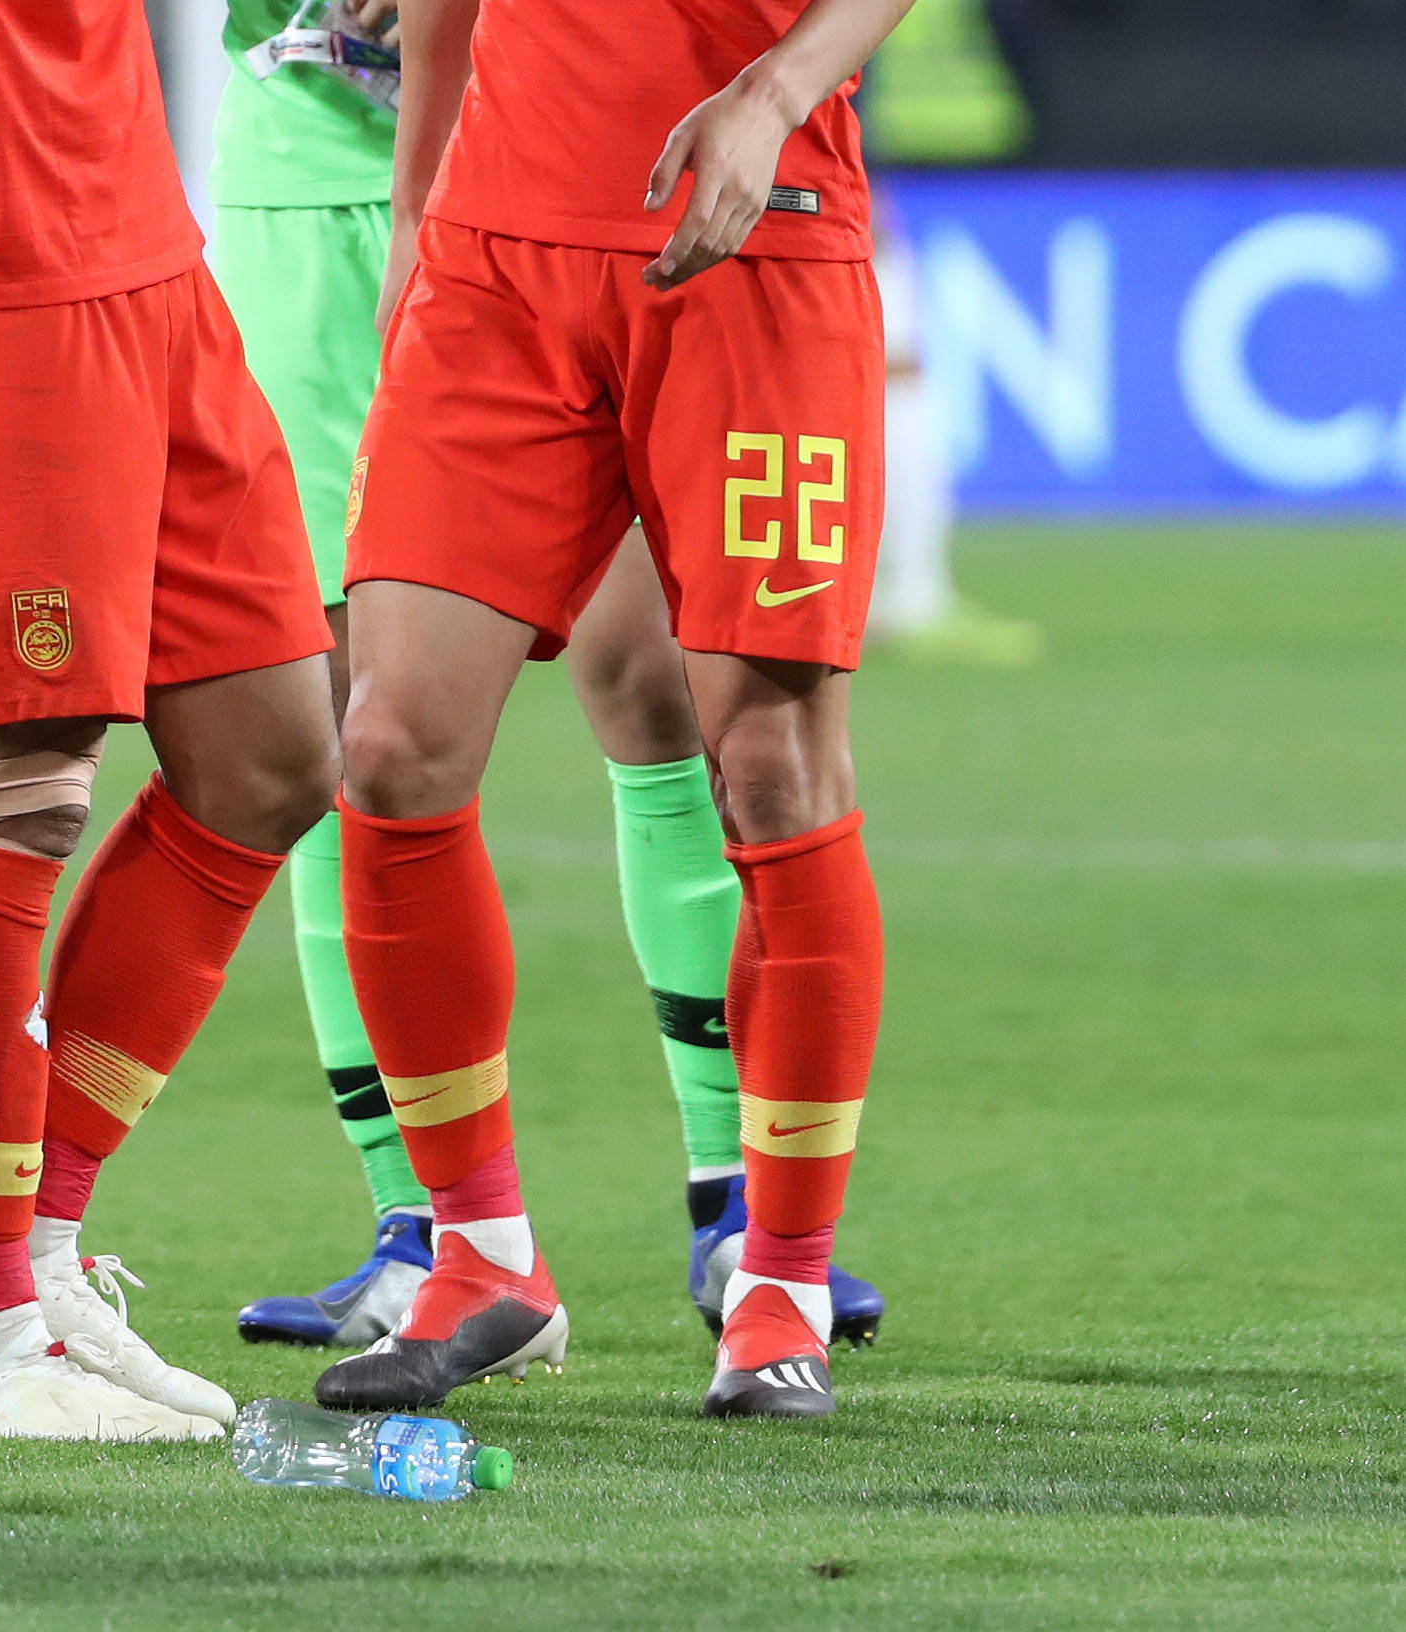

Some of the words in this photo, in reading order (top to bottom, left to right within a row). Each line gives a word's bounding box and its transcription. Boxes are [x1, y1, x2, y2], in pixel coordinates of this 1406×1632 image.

[1178, 211, 1406, 491] C
[723, 430, 848, 566] 22
[17, 593, 63, 610] CFA
